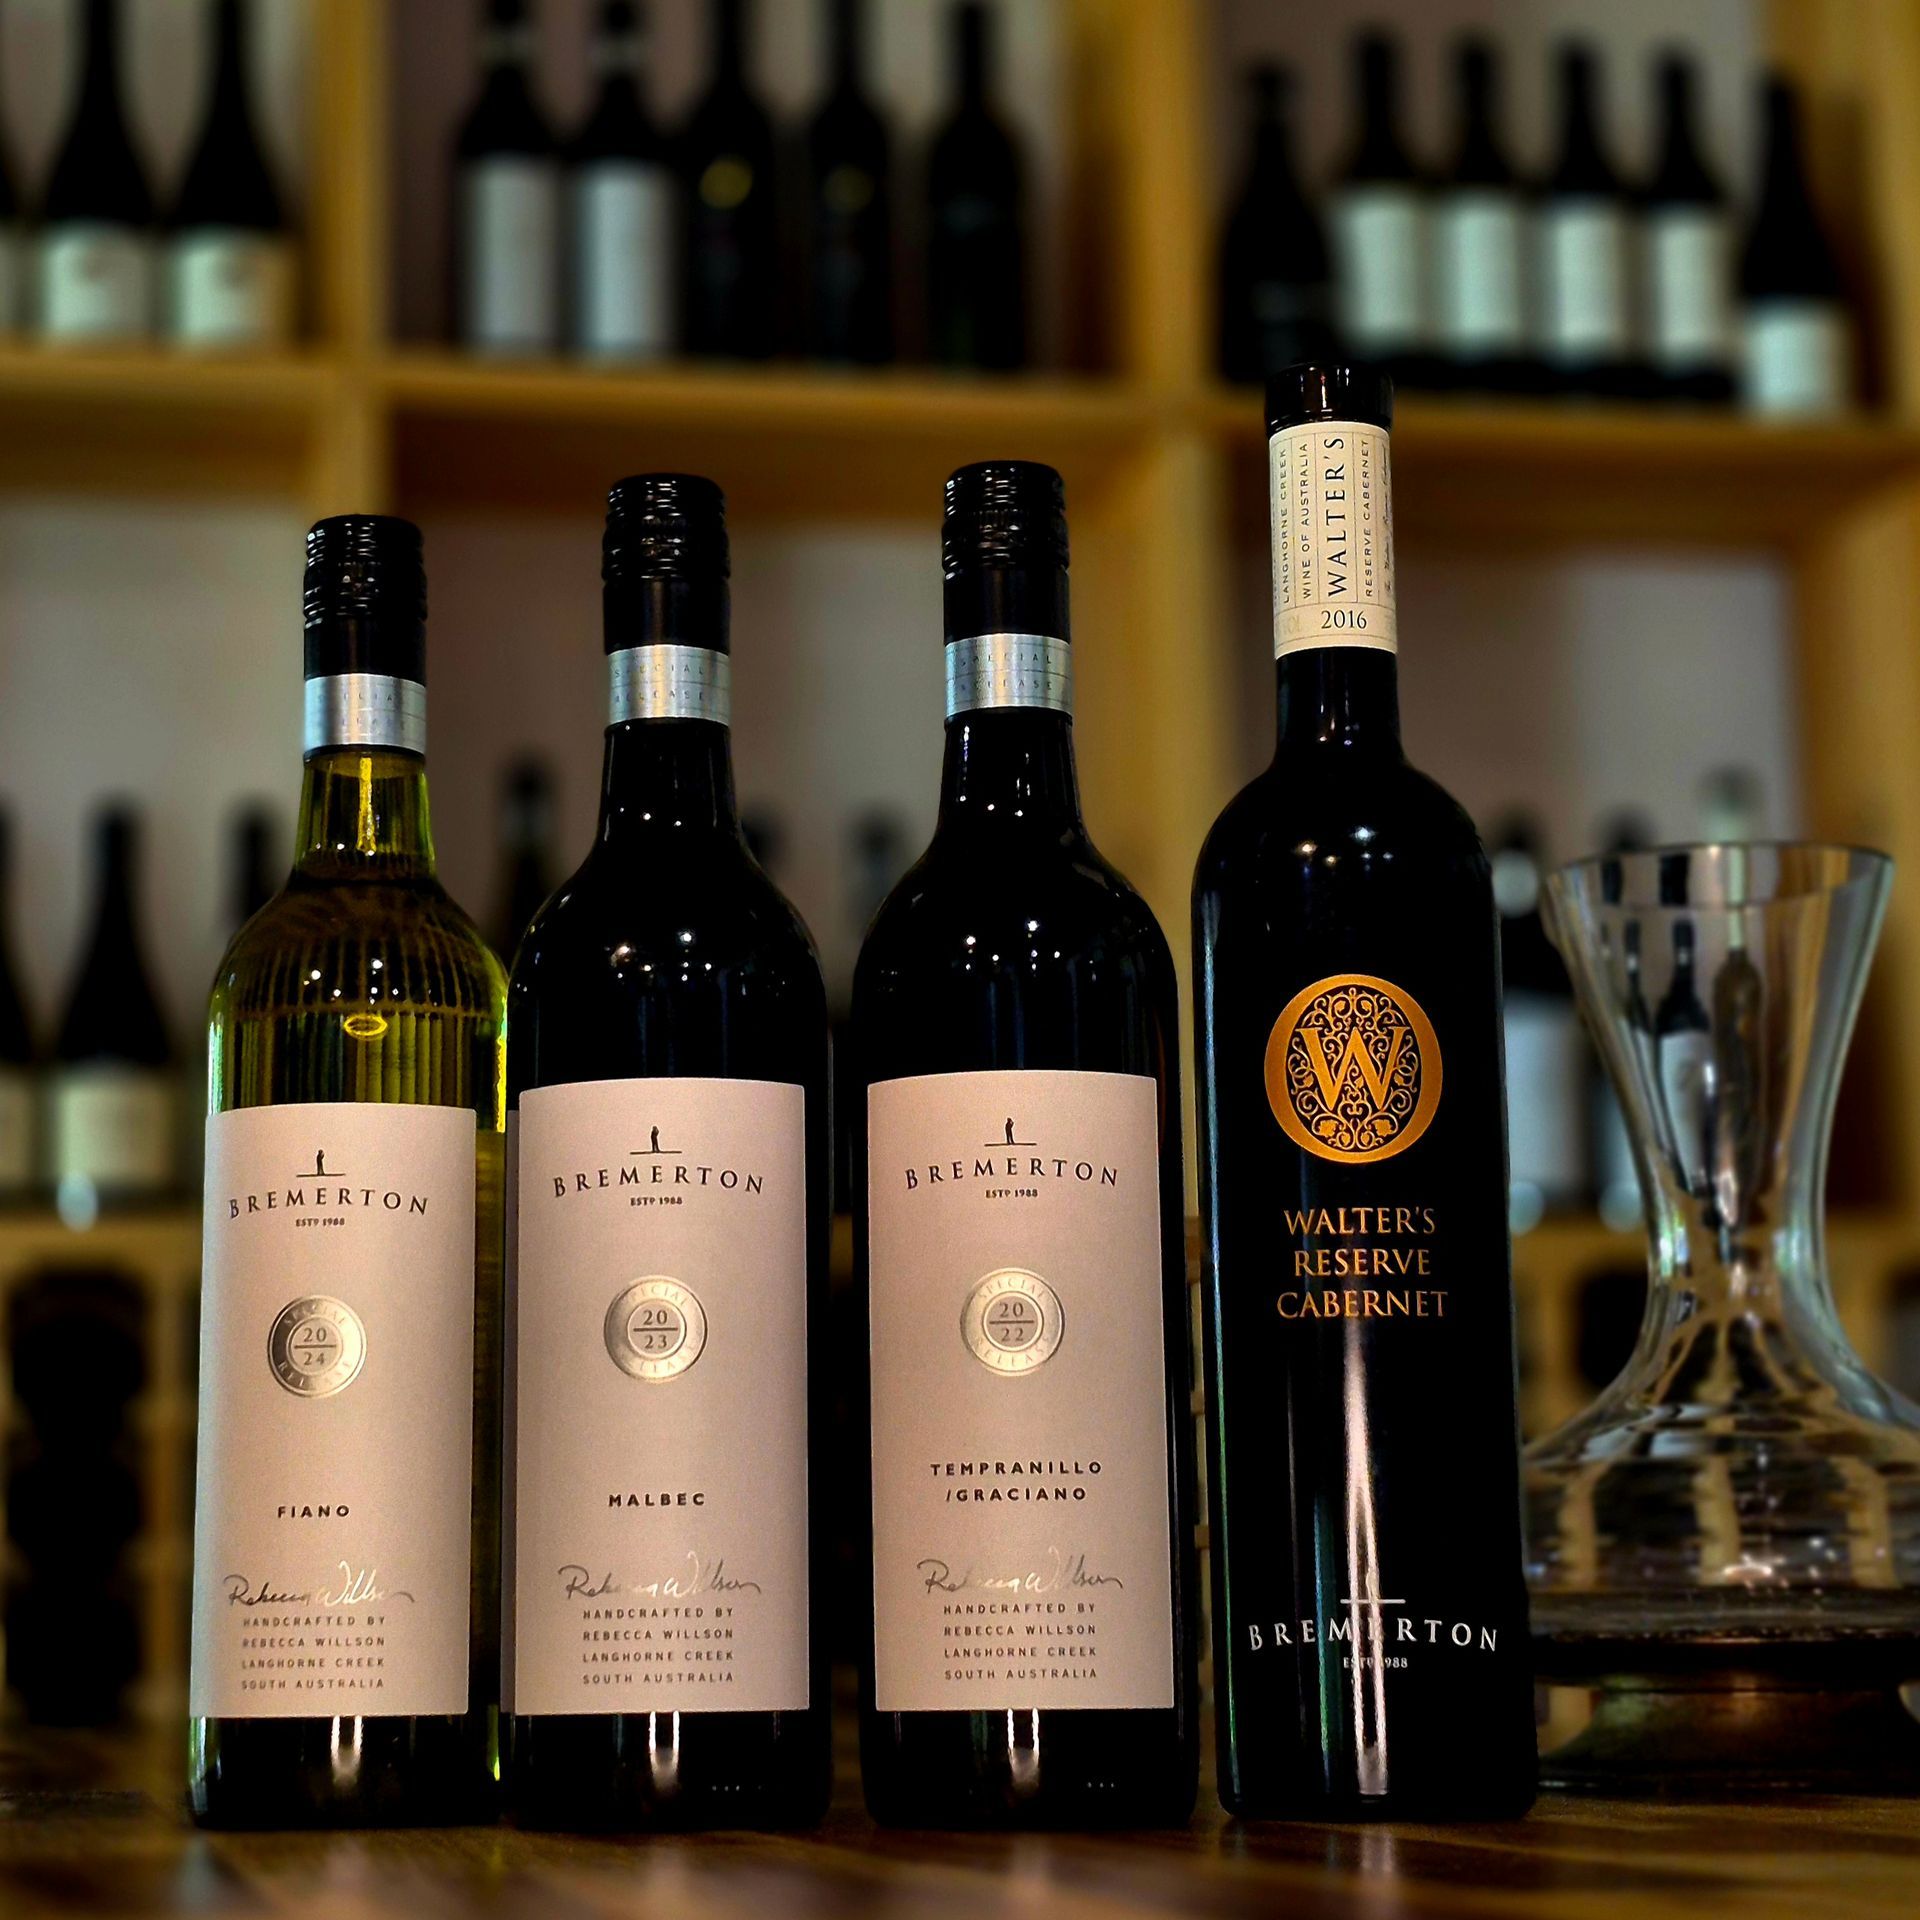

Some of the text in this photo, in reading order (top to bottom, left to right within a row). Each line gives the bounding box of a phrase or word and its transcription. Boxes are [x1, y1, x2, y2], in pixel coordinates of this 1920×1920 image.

[1299, 443, 1311, 599] WINE OF AUSTRALIA
[1324, 437, 1348, 597] WALTER'S
[1361, 440, 1374, 597] RESERVE CABERNET
[1279, 449, 1290, 604] LANGHORNE CREEK
[1320, 609, 1367, 630] 2016
[614, 664, 704, 678] SECIAL
[905, 1157, 1118, 1190] BREMERTON
[553, 1165, 764, 1198] BREMERTON
[1014, 1188, 1038, 1198] 1988
[230, 1187, 428, 1219] BREMERTON
[659, 1196, 683, 1206] 1988
[322, 1217, 346, 1227] 1988
[1284, 1206, 1436, 1236] WALTER'S
[1294, 1249, 1432, 1277] RESERVE
[1000, 1302, 1024, 1317] 20
[1277, 1289, 1448, 1320] CABERNET
[643, 1309, 668, 1325] 20
[303, 1327, 327, 1343] 20
[644, 1335, 668, 1349] 23
[1002, 1328, 1024, 1342] 22
[303, 1352, 325, 1366] 24
[930, 1461, 1102, 1476] TEMPRANILLO
[608, 1493, 706, 1507] MALBEC
[945, 1487, 1087, 1502] /GRACIANO
[277, 1504, 351, 1519] FIANO
[583, 1607, 734, 1620] HANDCRAFTED BY
[943, 1603, 1096, 1615] HANDCRAFTED BY
[243, 1616, 386, 1628] HANDCRAFTED BY
[583, 1629, 734, 1641] REBECCA WILLSON
[944, 1624, 1096, 1636] REBECCA WILLSON
[242, 1636, 386, 1649] REBECCA WILLSON
[583, 1651, 734, 1663] LANGHORNE CREEK
[944, 1646, 1097, 1658] LANGHORNE CREEK
[242, 1657, 385, 1670] LANGHORNE CREEK
[583, 1672, 734, 1684] SOUTH AUSTRALIA
[945, 1668, 1097, 1680] SOUTH AUSTRALIA
[241, 1678, 385, 1690] SOUTH AUSTRALIA
